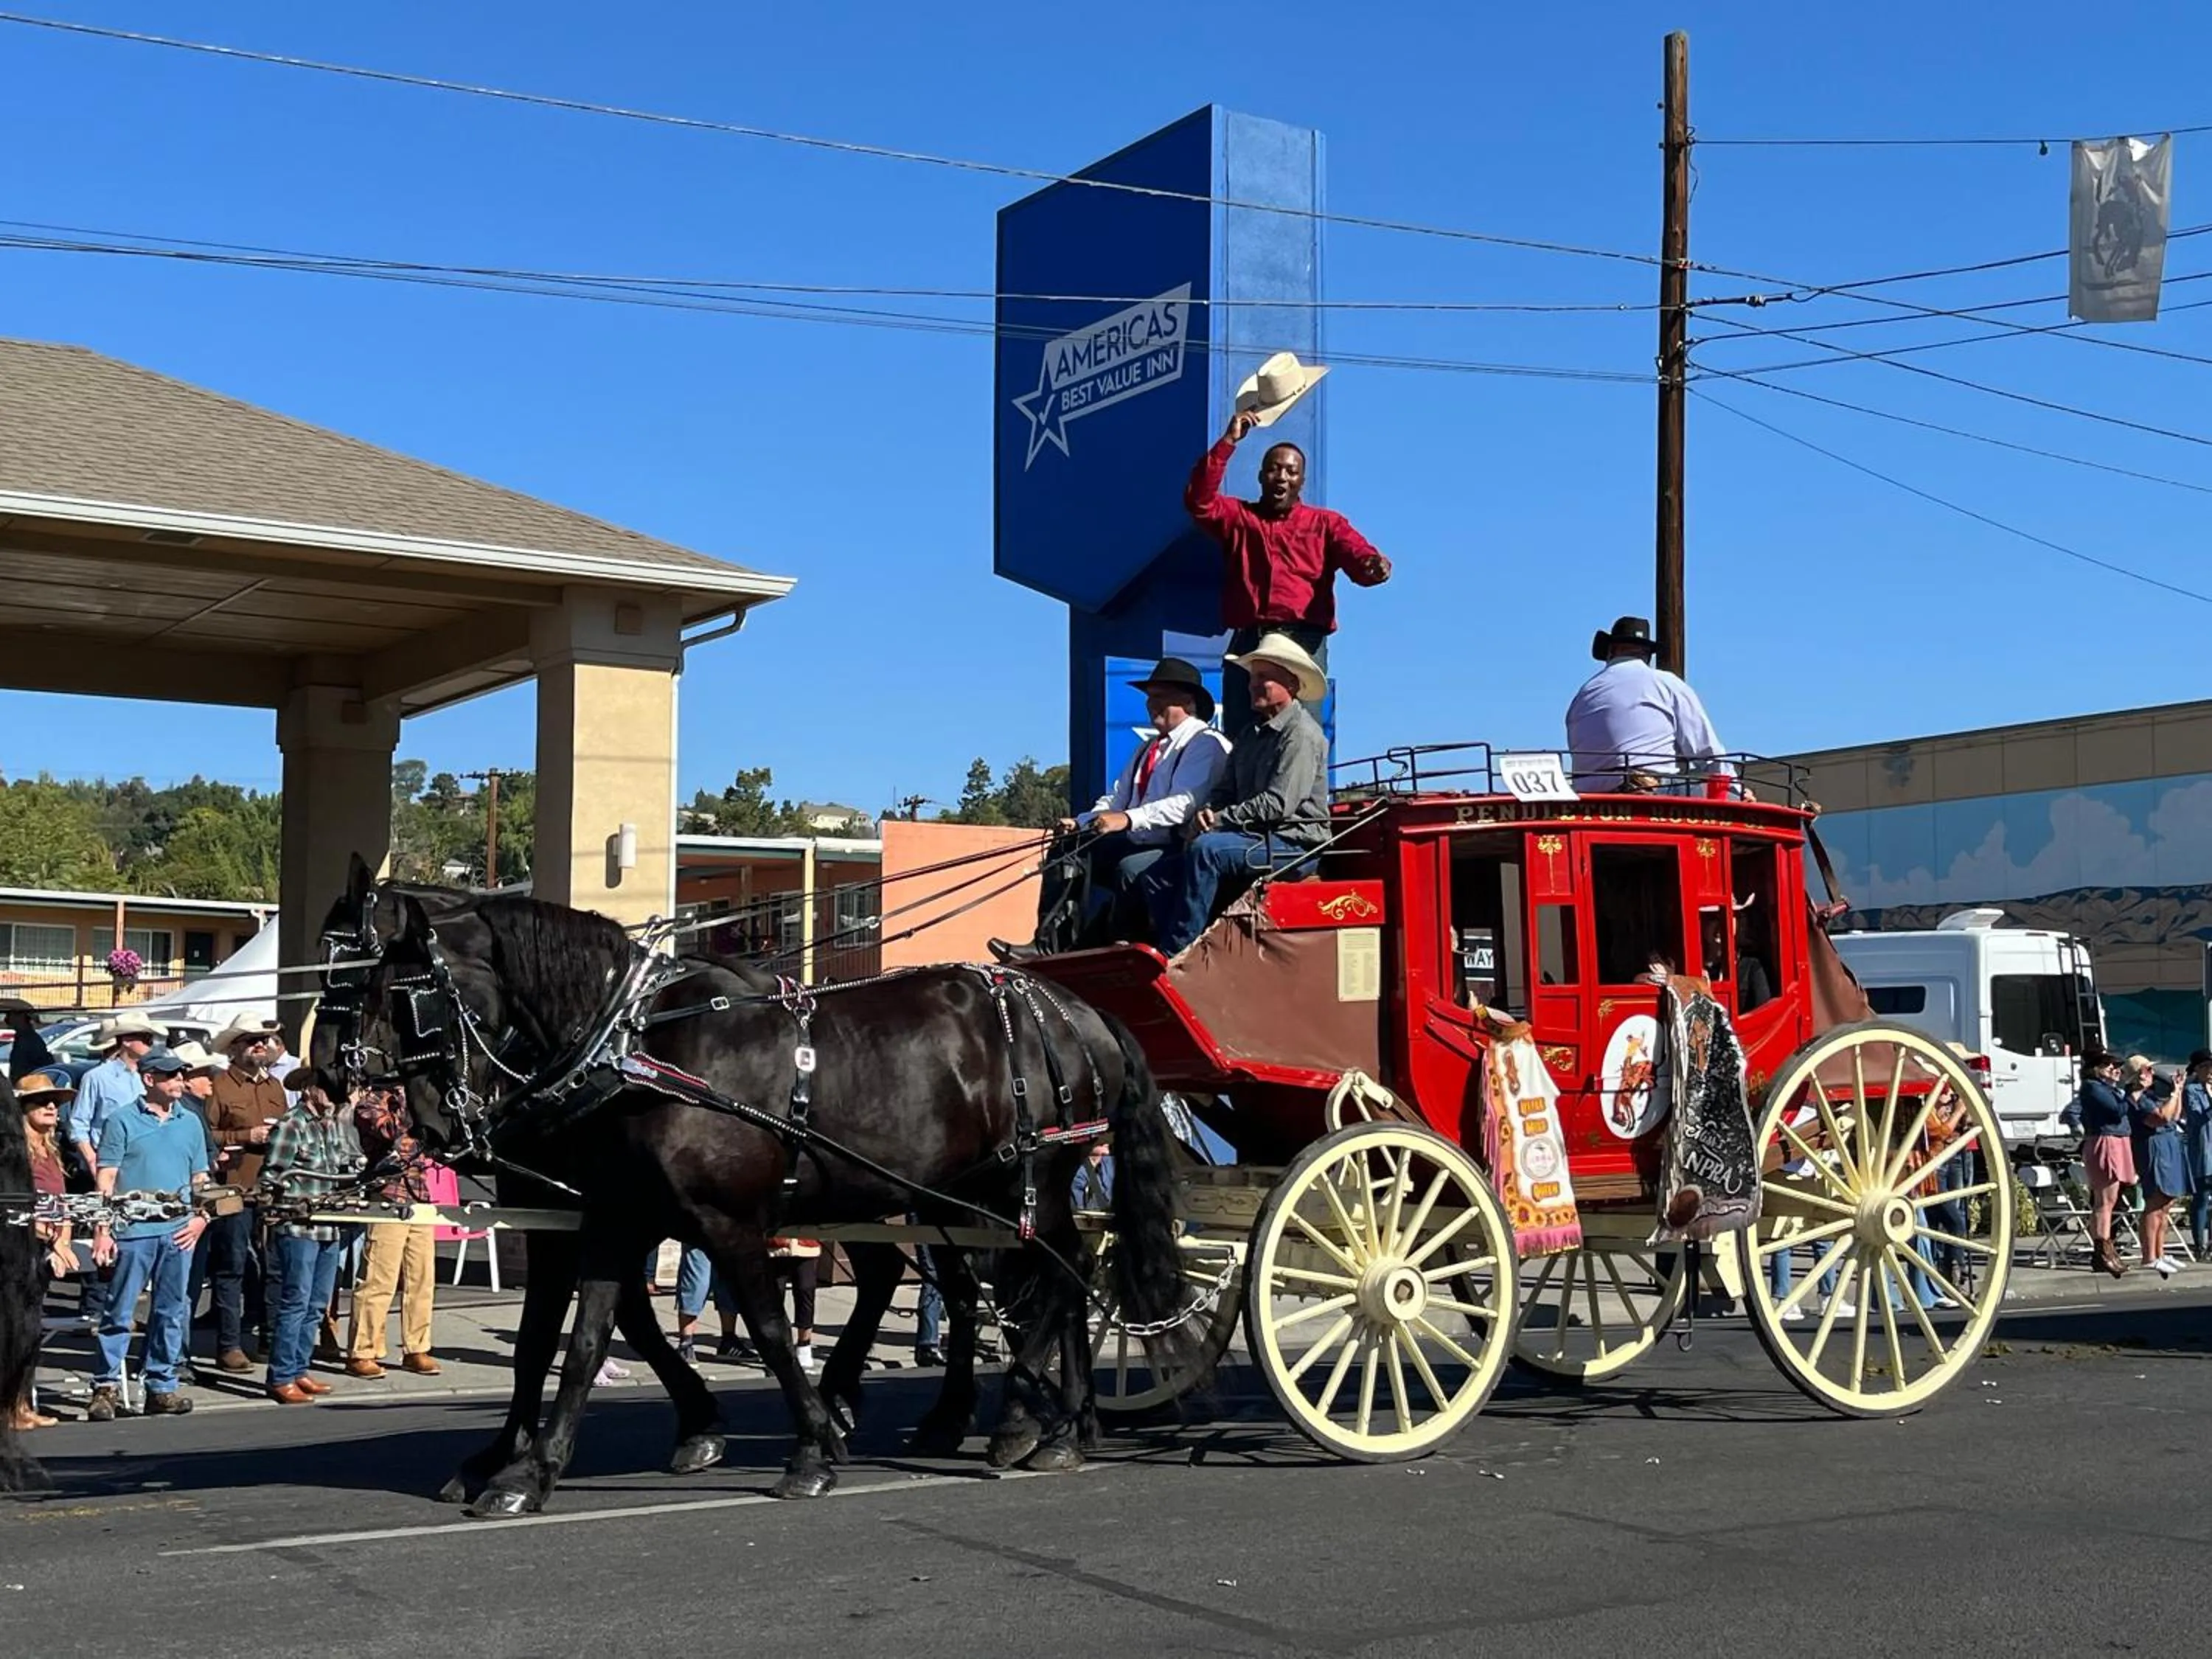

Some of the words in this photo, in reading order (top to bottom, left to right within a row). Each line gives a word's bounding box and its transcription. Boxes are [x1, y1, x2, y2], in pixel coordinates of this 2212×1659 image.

[1054, 303, 1178, 382] AMERICAS
[1062, 381, 1095, 411] BEST
[1096, 362, 1142, 395] VALUE
[1147, 348, 1175, 378] INN
[1512, 770, 1559, 793] 037
[1455, 804, 1632, 824] PENDLETON
[1466, 950, 1493, 966] WAY
[1684, 1149, 1742, 1194] NPRA
